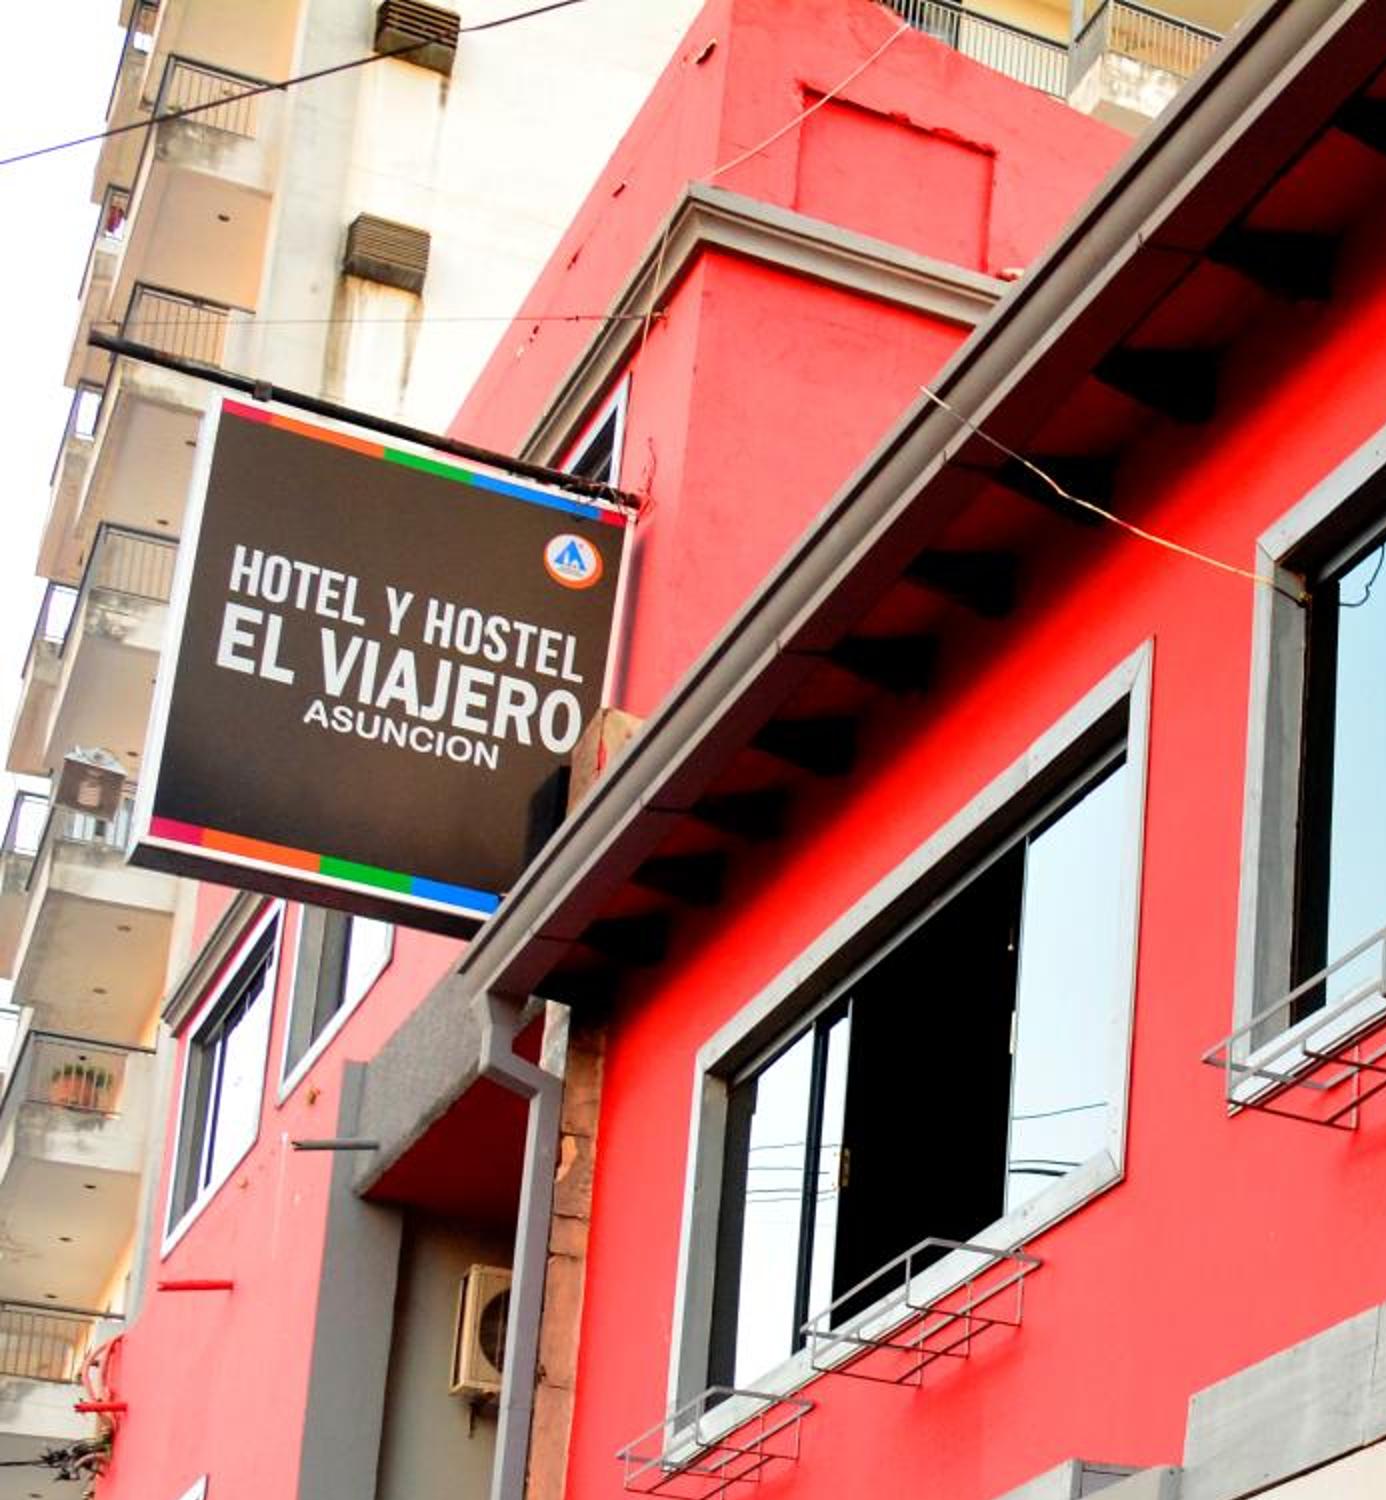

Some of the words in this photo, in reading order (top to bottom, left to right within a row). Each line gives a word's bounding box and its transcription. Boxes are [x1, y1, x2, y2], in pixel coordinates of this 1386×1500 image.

[216, 601, 295, 685] EL
[320, 627, 583, 754] VIAJERO
[229, 544, 365, 626] HOTEL
[385, 586, 414, 636] Y
[423, 598, 583, 684] HOSTEL
[303, 699, 499, 770] ASUNCION
